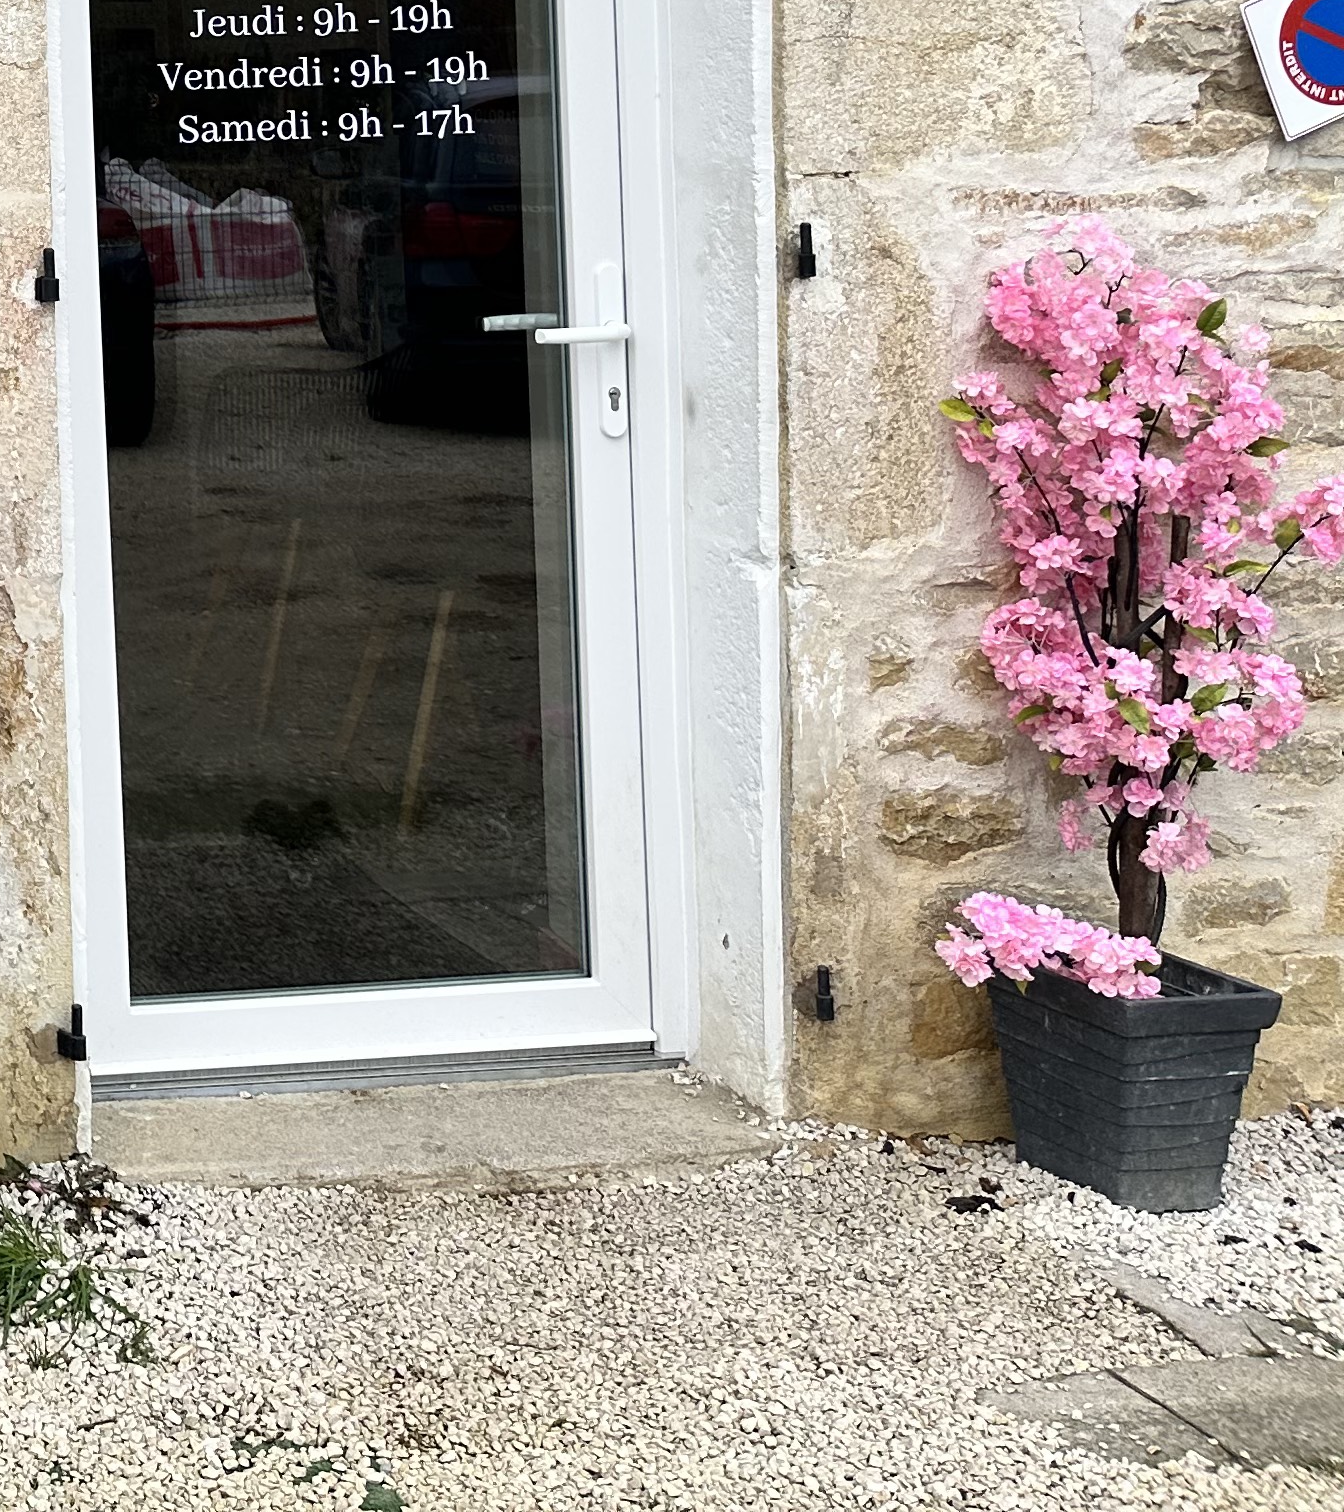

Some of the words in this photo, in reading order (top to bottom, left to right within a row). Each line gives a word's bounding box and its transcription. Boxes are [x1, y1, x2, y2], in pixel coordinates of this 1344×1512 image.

[189, 4, 288, 38] Jeudi
[313, 2, 359, 37] 9h
[390, 0, 454, 34] 19h
[156, 56, 324, 91] Vendredi
[350, 54, 396, 88] 9h
[426, 50, 490, 85] 19h
[1282, 40, 1327, 99] INTERDIT
[178, 109, 312, 144] Samedi
[338, 107, 384, 142] 9h
[414, 104, 476, 140] 17h
